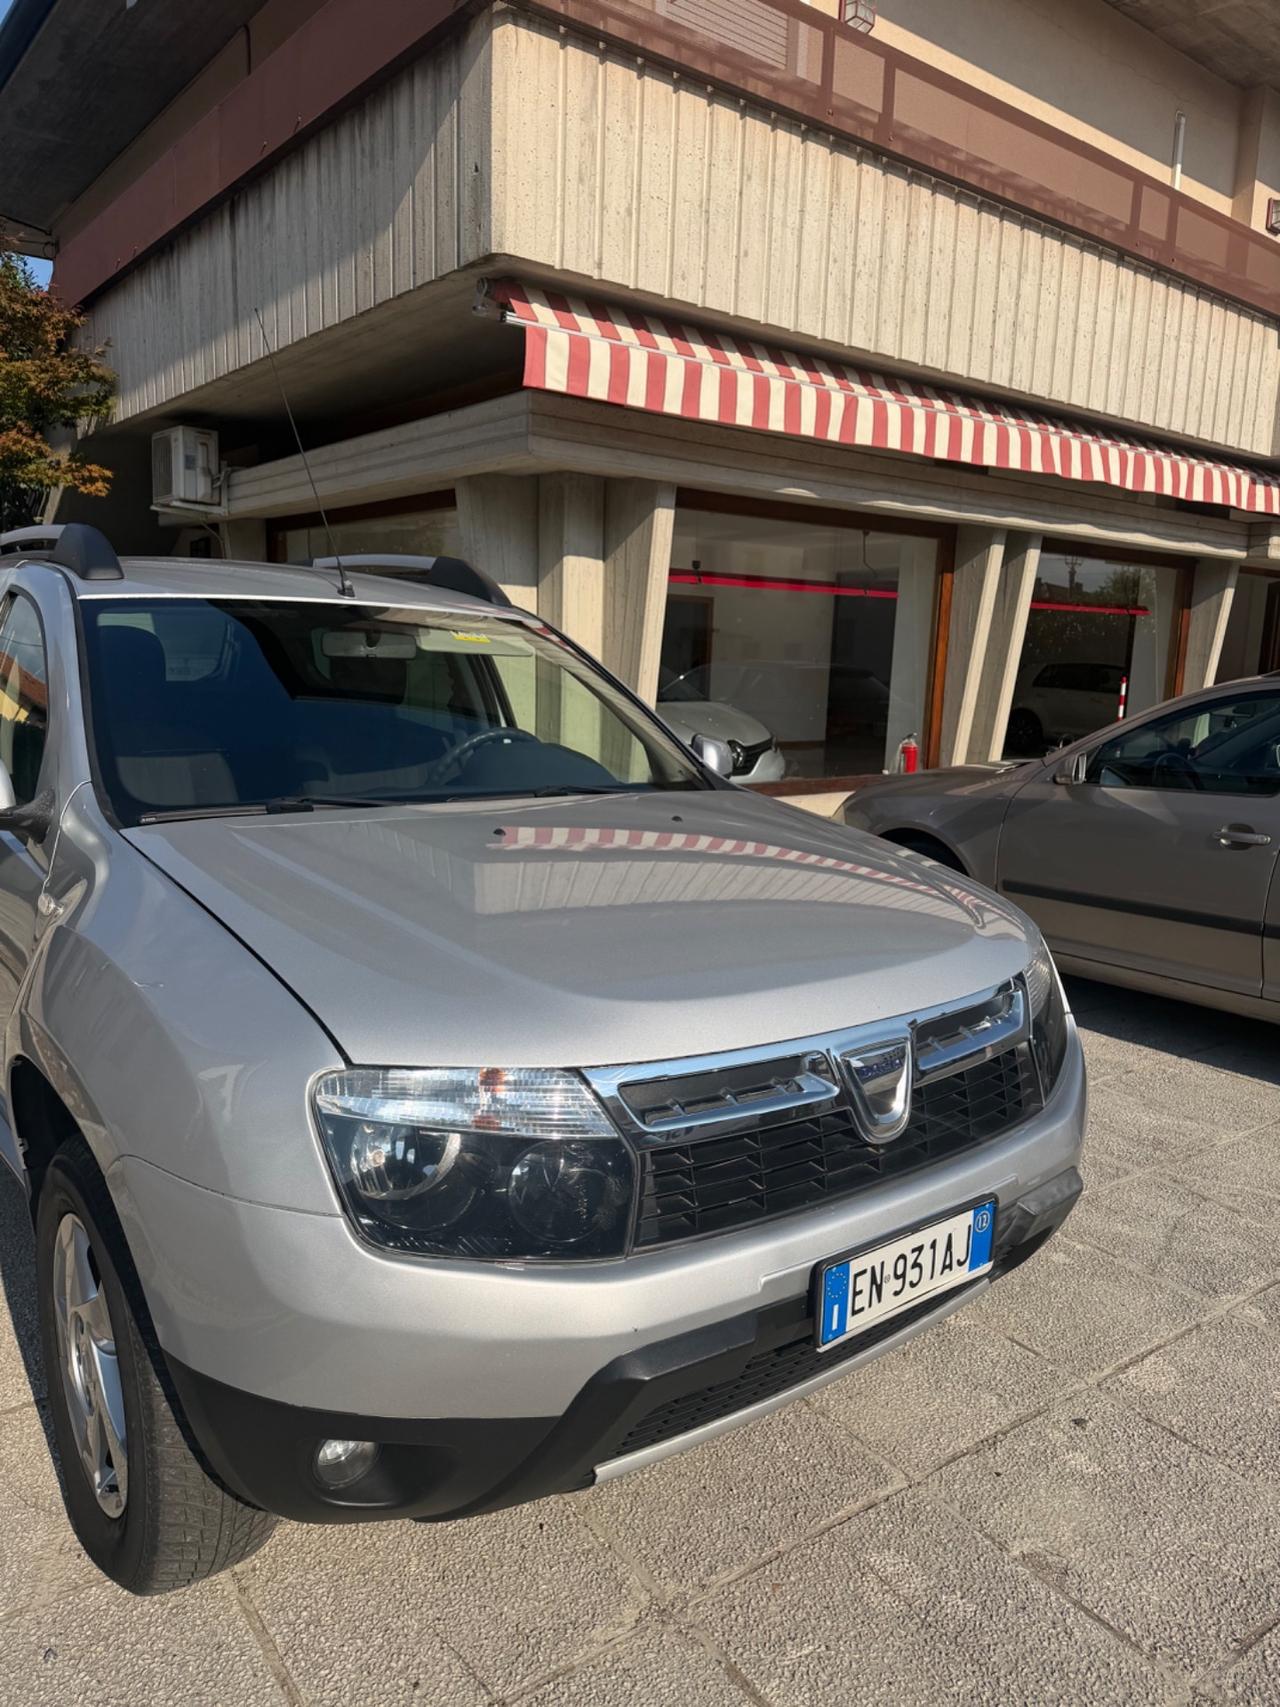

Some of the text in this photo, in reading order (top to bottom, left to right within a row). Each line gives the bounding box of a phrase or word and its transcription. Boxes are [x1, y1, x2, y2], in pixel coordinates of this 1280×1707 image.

[851, 1224, 972, 1317] EN 931AJ
[832, 1303, 839, 1331] I
